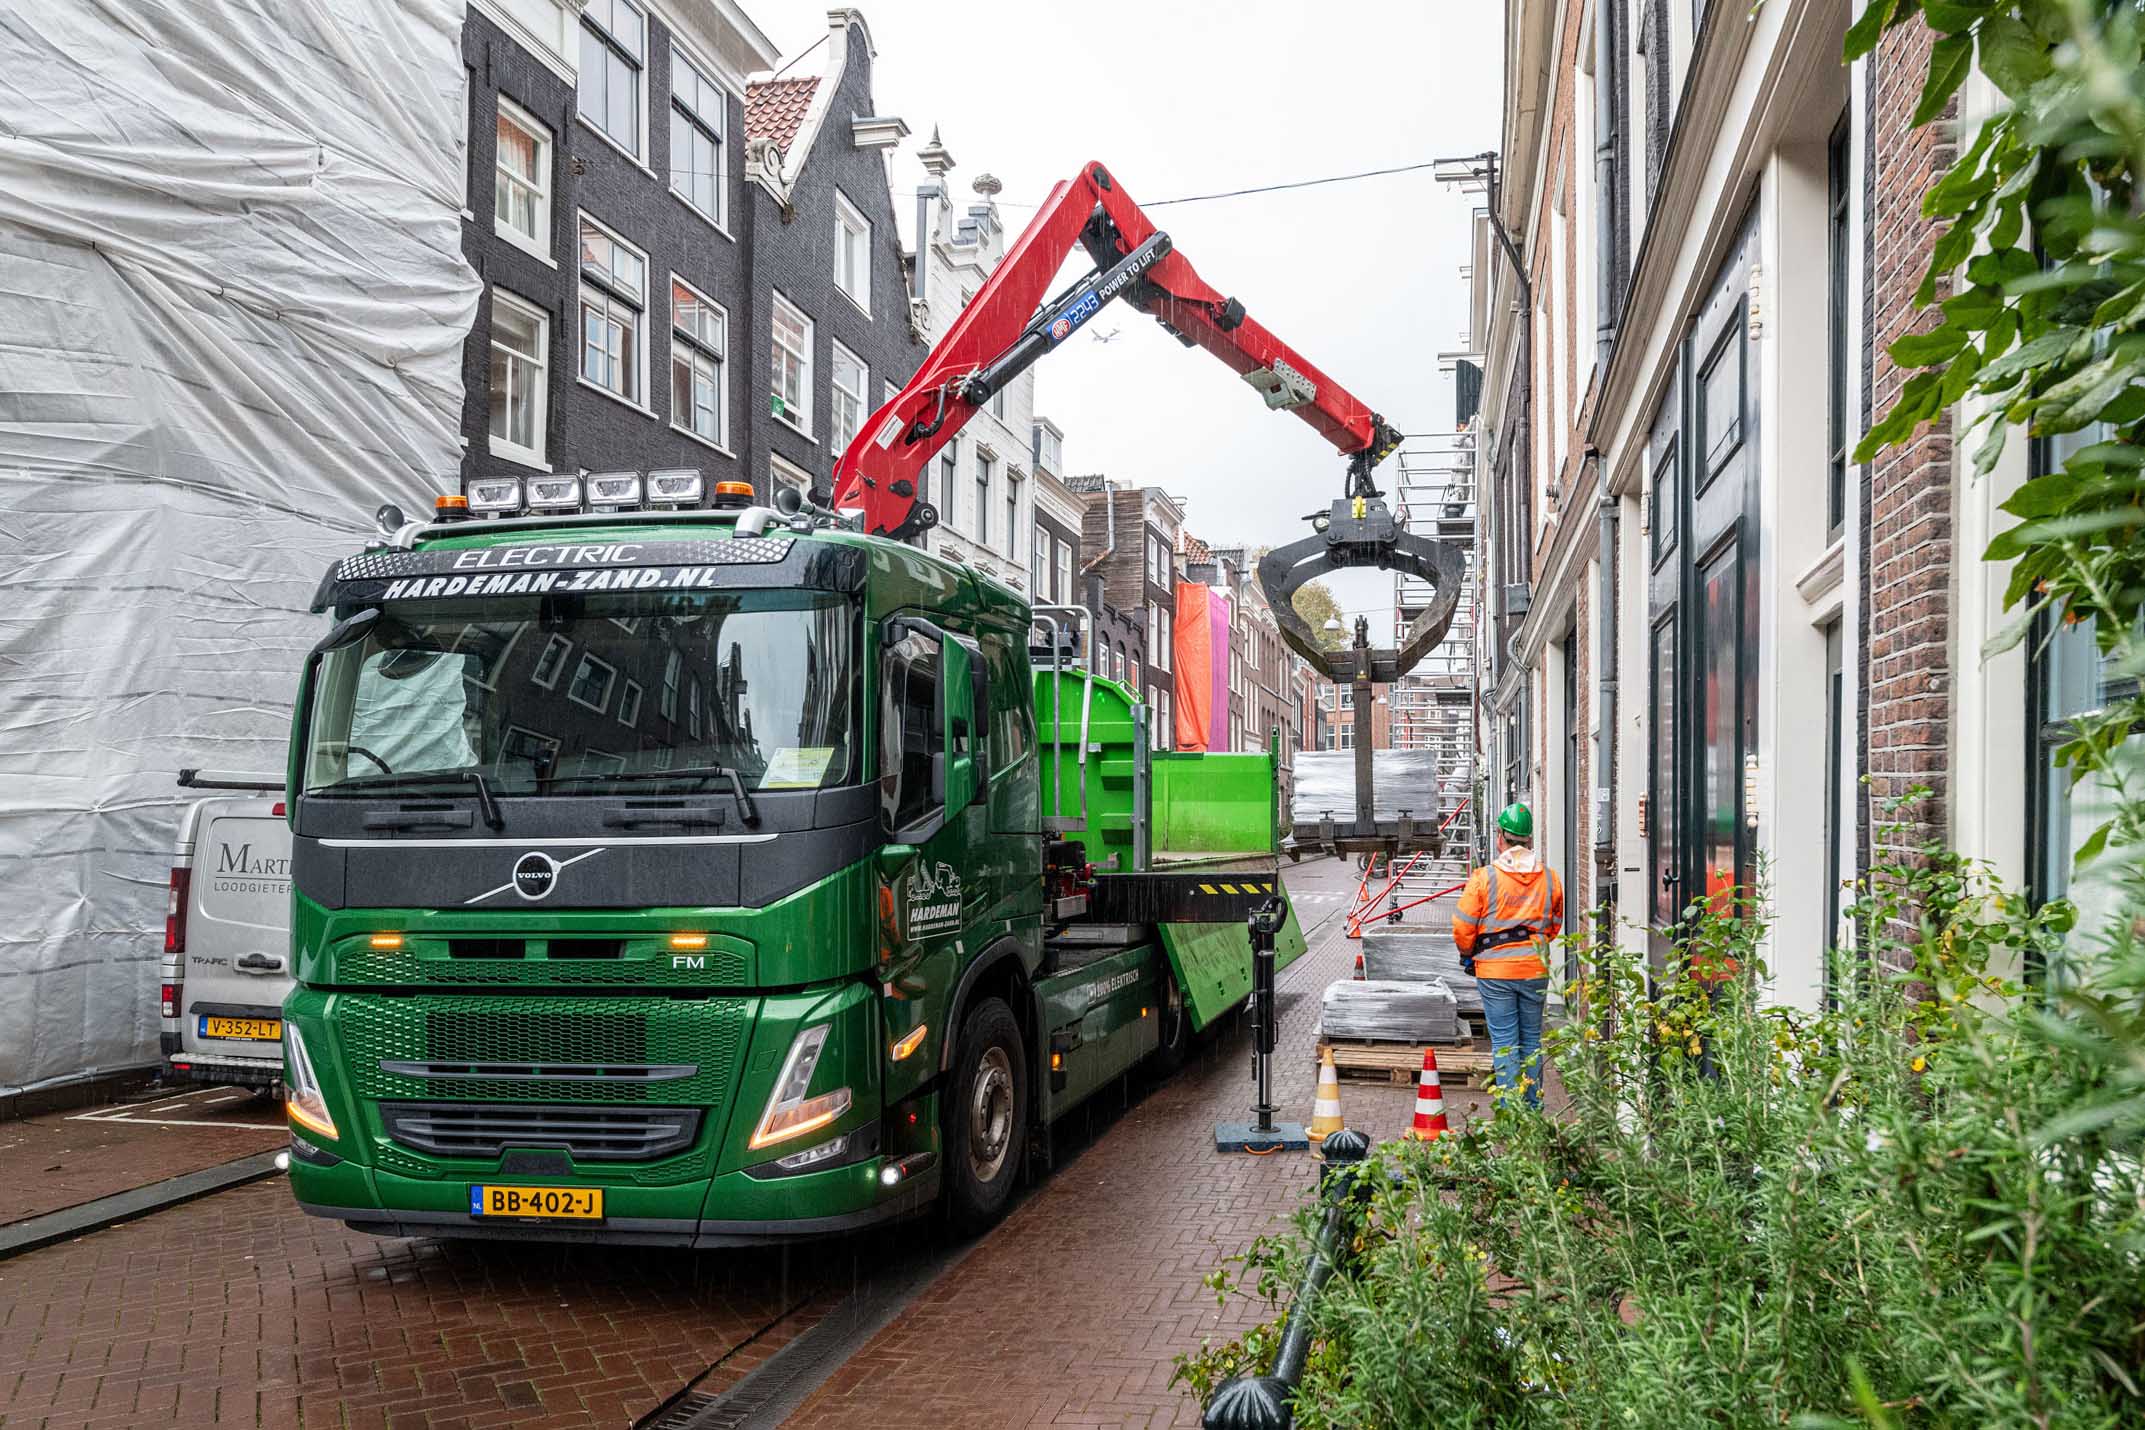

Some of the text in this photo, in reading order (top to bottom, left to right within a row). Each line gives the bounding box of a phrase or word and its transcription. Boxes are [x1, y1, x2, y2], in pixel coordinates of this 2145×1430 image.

[1099, 248, 1155, 300] POWER TO LIFT
[1070, 294, 1099, 324] 2243
[452, 544, 643, 569] ELECTRIC
[382, 567, 717, 600] HARDEMAN-ZAND.NL
[910, 902, 960, 923] HARDEMAN
[192, 956, 228, 966] TRAFIC
[672, 956, 704, 969] FM
[1111, 968, 1139, 991] ELEKTRISCH
[213, 1020, 276, 1036] V-352-LT
[492, 1190, 594, 1214] BB-402-J
